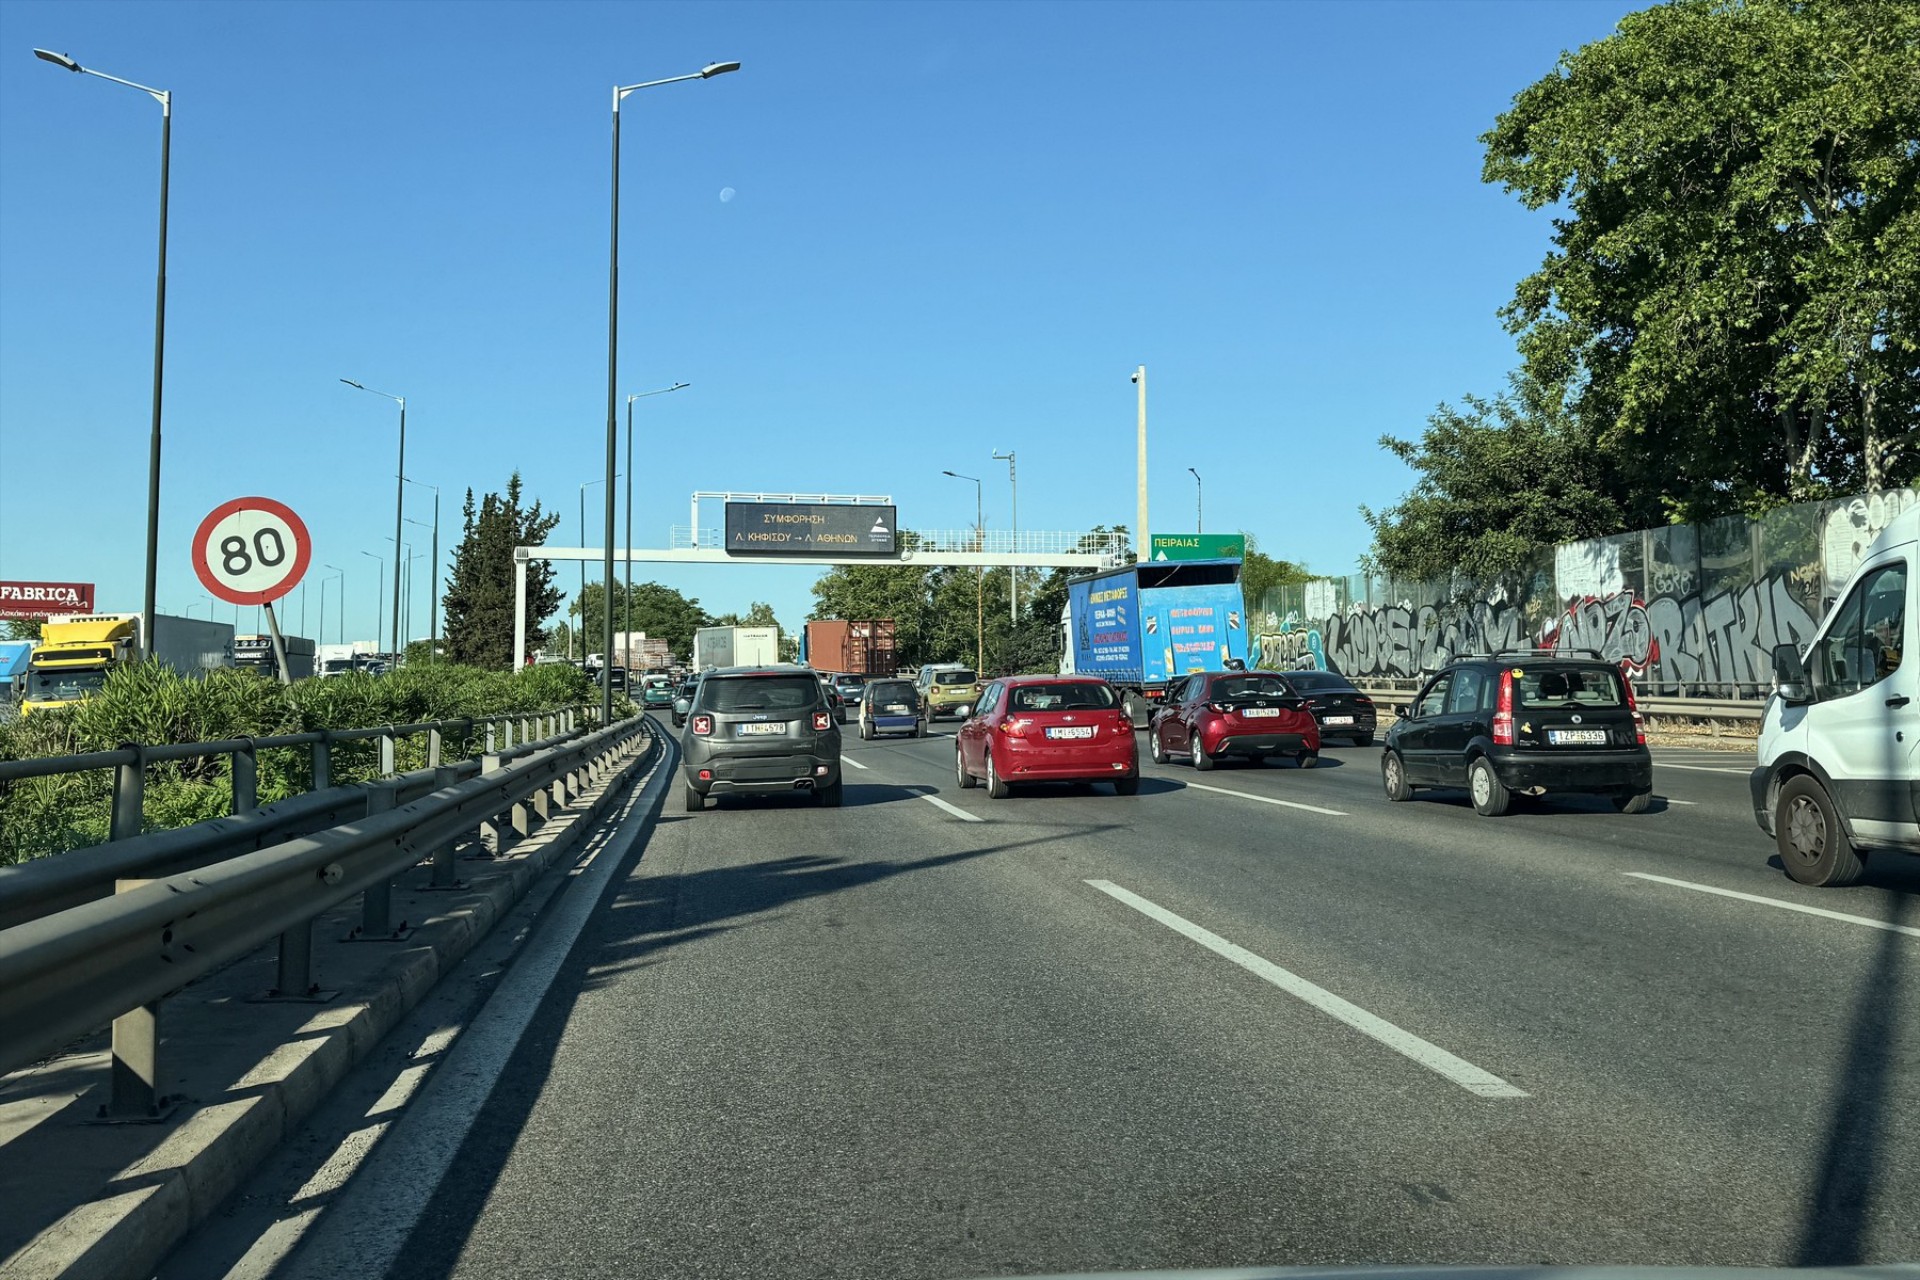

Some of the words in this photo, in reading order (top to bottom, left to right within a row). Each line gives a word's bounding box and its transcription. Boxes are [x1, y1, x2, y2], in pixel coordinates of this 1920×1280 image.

[764, 514, 825, 524] ΣΥΜΦΟΡΗΣΗ
[748, 532, 792, 542] ΚΗΦΙΣΟΥ
[817, 533, 858, 544] ΑΘΗΝΩΝ
[1154, 538, 1200, 548] ΠΕΙΡΑΙΑΣ
[221, 528, 285, 576] 80
[0, 586, 79, 601] FABRICA
